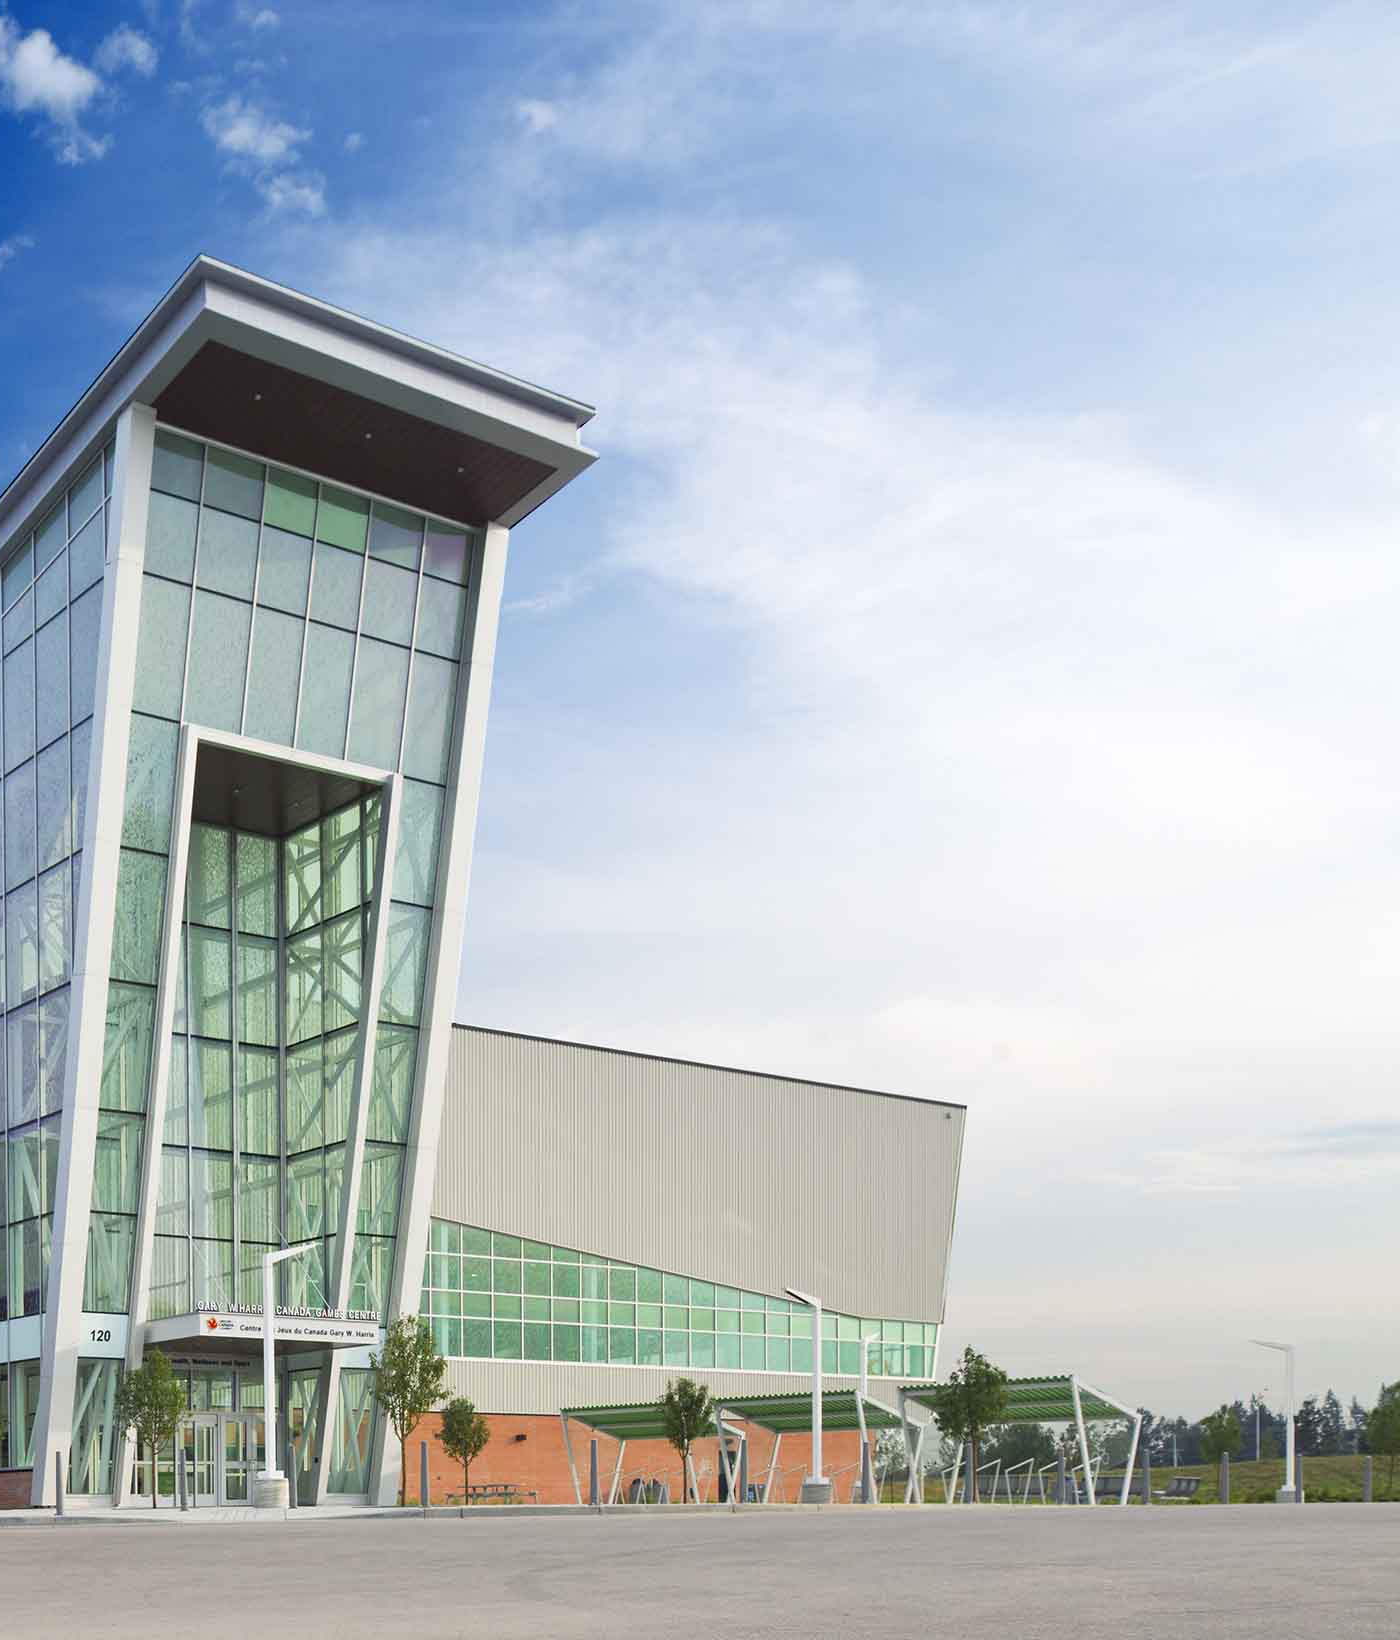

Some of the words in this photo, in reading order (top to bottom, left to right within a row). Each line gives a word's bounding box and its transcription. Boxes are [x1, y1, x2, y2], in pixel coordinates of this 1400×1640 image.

[198, 1300, 222, 1312] GARY
[239, 1304, 263, 1315] HARR
[276, 1305, 310, 1317] CANADA
[315, 1309, 344, 1320] GAMES
[349, 1310, 381, 1321] CENTRE
[90, 1329, 111, 1342] 120
[239, 1324, 262, 1332] Centre
[303, 1328, 328, 1336] Canada
[329, 1329, 344, 1337] Gary
